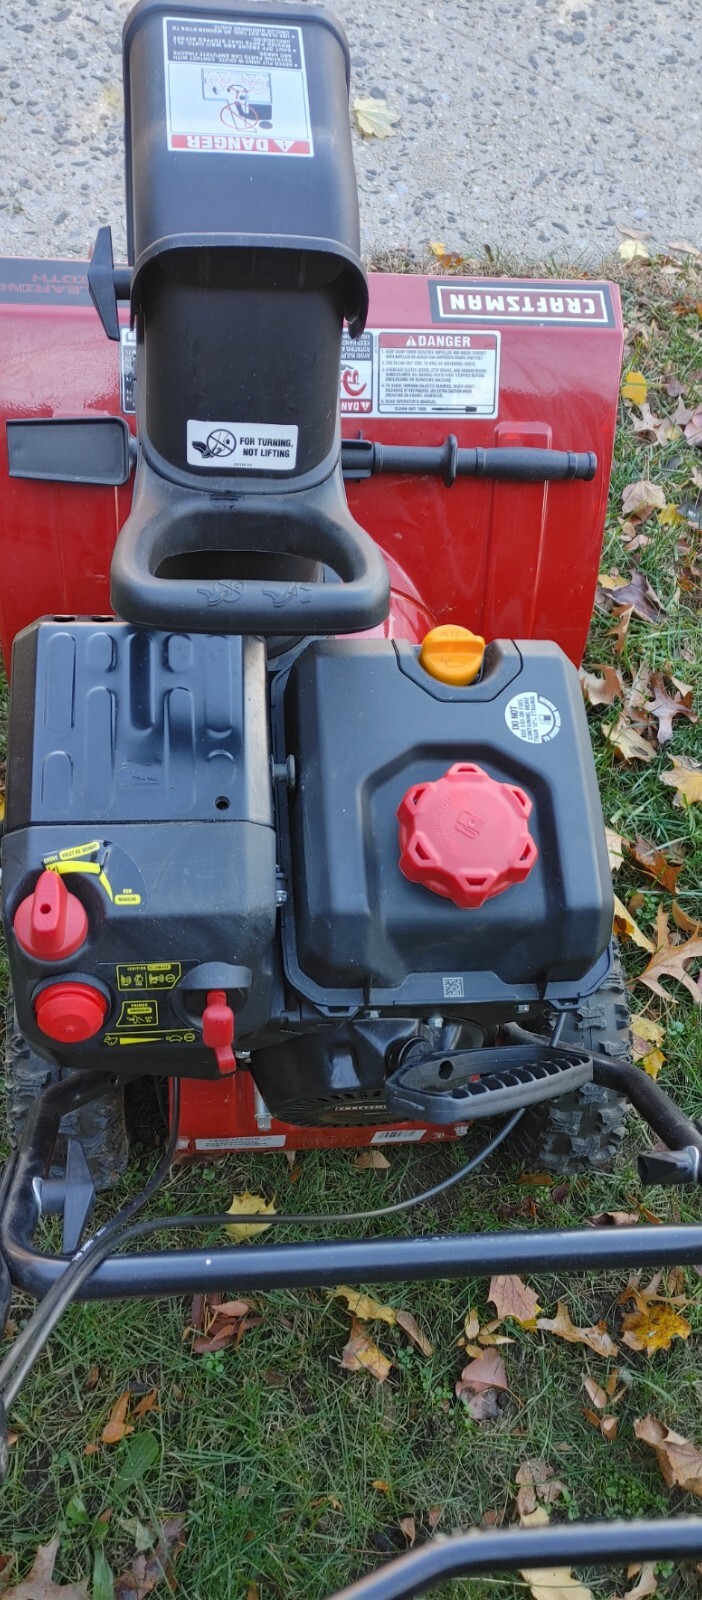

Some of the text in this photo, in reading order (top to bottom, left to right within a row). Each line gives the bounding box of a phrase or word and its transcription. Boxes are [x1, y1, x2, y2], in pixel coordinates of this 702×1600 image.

[186, 136, 268, 152] DANGER
[450, 294, 595, 314] CRAFTSMAN
[418, 336, 471, 347] DANGER
[240, 437, 294, 448] FOR TURNING,
[260, 449, 290, 458] LIFTING
[510, 705, 519, 730] DO NOT
[525, 711, 533, 740] CONTAINING
